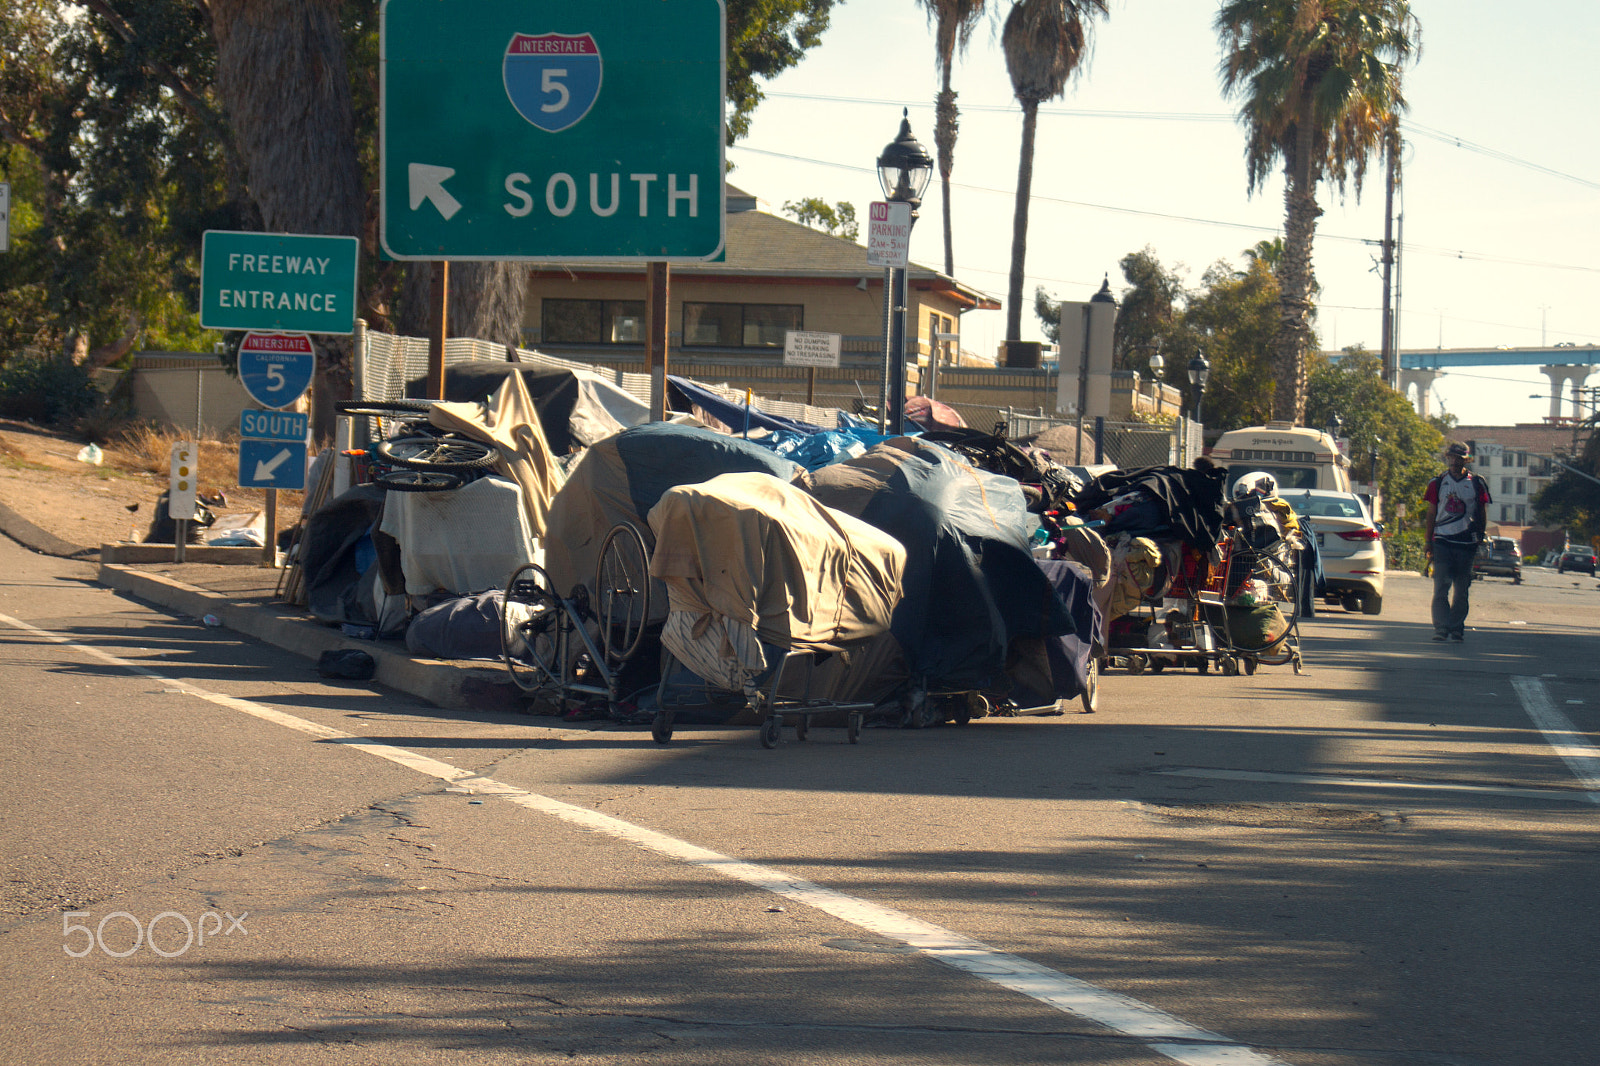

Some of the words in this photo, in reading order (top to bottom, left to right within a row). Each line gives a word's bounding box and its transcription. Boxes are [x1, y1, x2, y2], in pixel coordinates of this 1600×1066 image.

[519, 40, 586, 53] INTERSTATE
[540, 68, 570, 113] 5
[503, 172, 699, 218] SOUTH
[871, 204, 886, 219] NO
[871, 223, 907, 237] PARKING
[872, 249, 902, 259] TUESDAY
[228, 253, 330, 275] FREEWAY
[219, 289, 336, 312] ENTRANCE
[248, 337, 307, 350] INTERSTATE
[804, 338, 830, 346] DUMPING
[255, 353, 298, 363] CALIFORNIA
[797, 350, 836, 359] TRESPASSING
[265, 363, 285, 392] 5
[244, 414, 304, 437] SOUTH
